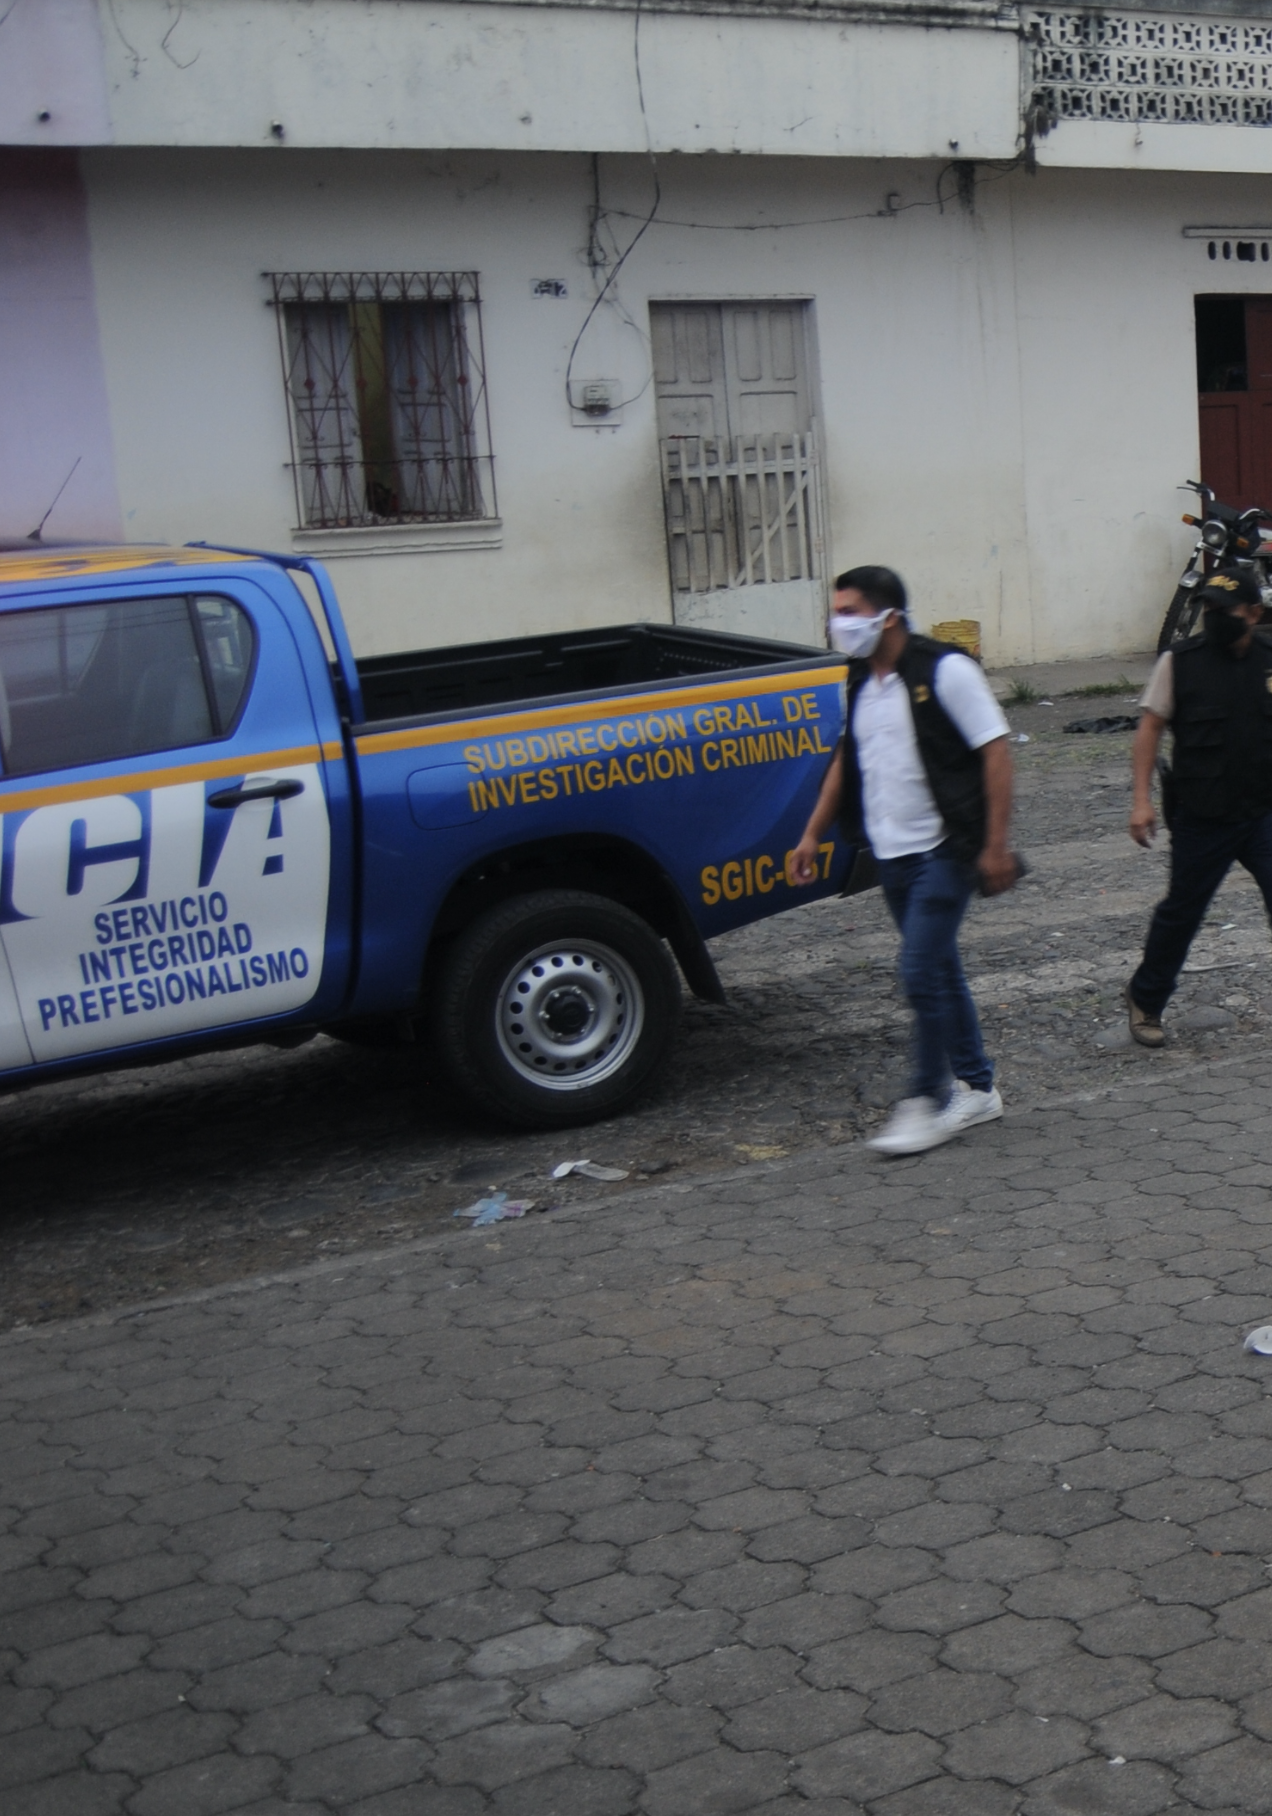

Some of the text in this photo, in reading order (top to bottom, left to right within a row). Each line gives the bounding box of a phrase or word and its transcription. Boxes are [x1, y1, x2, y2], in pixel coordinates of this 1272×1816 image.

[463, 693, 821, 775] SUBDIRECCIÓN GRAL. DE
[468, 725, 832, 813] INVESTIGACIÓN CRIMINAL
[0, 763, 325, 925] CIA
[701, 841, 835, 906] SGIC-7
[79, 922, 252, 985] INTEGRIDAD
[94, 891, 228, 945] SERVICIO
[38, 947, 309, 1031] PREFESIONALISMO
